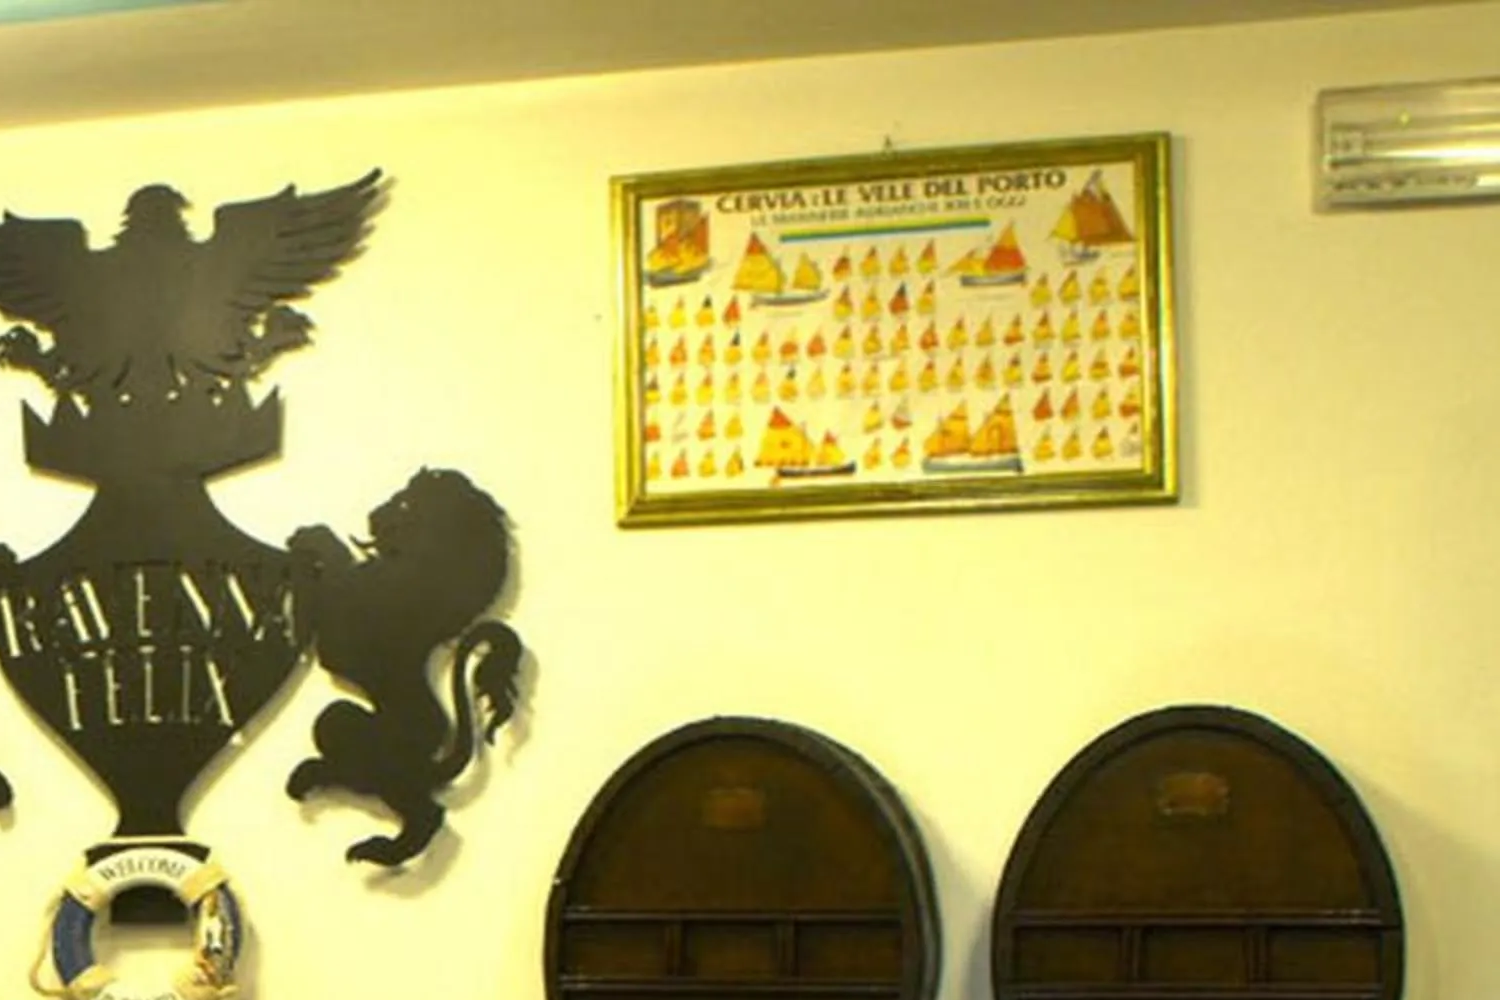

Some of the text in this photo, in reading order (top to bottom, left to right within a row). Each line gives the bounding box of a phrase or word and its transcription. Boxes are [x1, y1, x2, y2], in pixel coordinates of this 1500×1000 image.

[822, 187, 846, 208] LE
[858, 182, 912, 204] VELE
[924, 178, 968, 199] DEL
[976, 169, 1068, 194] PORTO
[55, 645, 239, 732] FELIX
[97, 857, 187, 882] WELCOME
